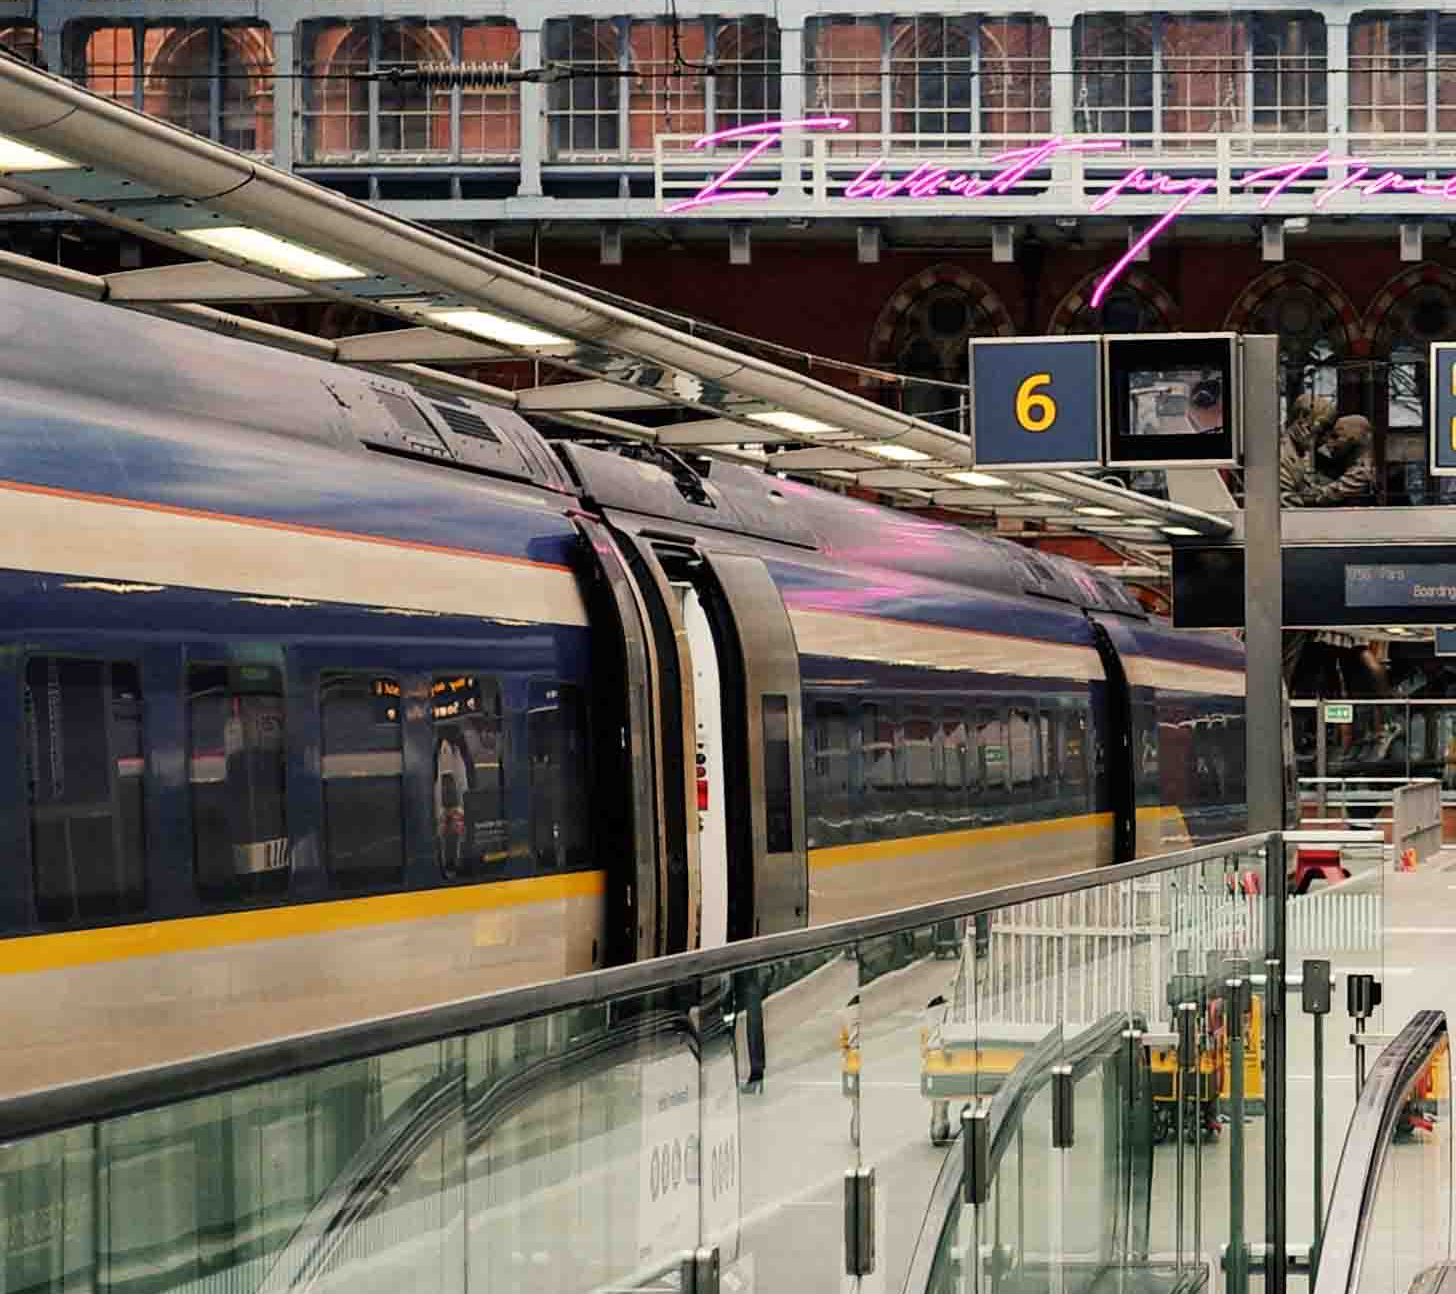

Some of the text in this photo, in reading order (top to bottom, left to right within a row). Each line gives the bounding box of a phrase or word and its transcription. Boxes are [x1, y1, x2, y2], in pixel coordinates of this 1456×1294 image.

[664, 116, 850, 212] I
[1014, 373, 1057, 432] 6
[1413, 584, 1456, 600] Boarding
